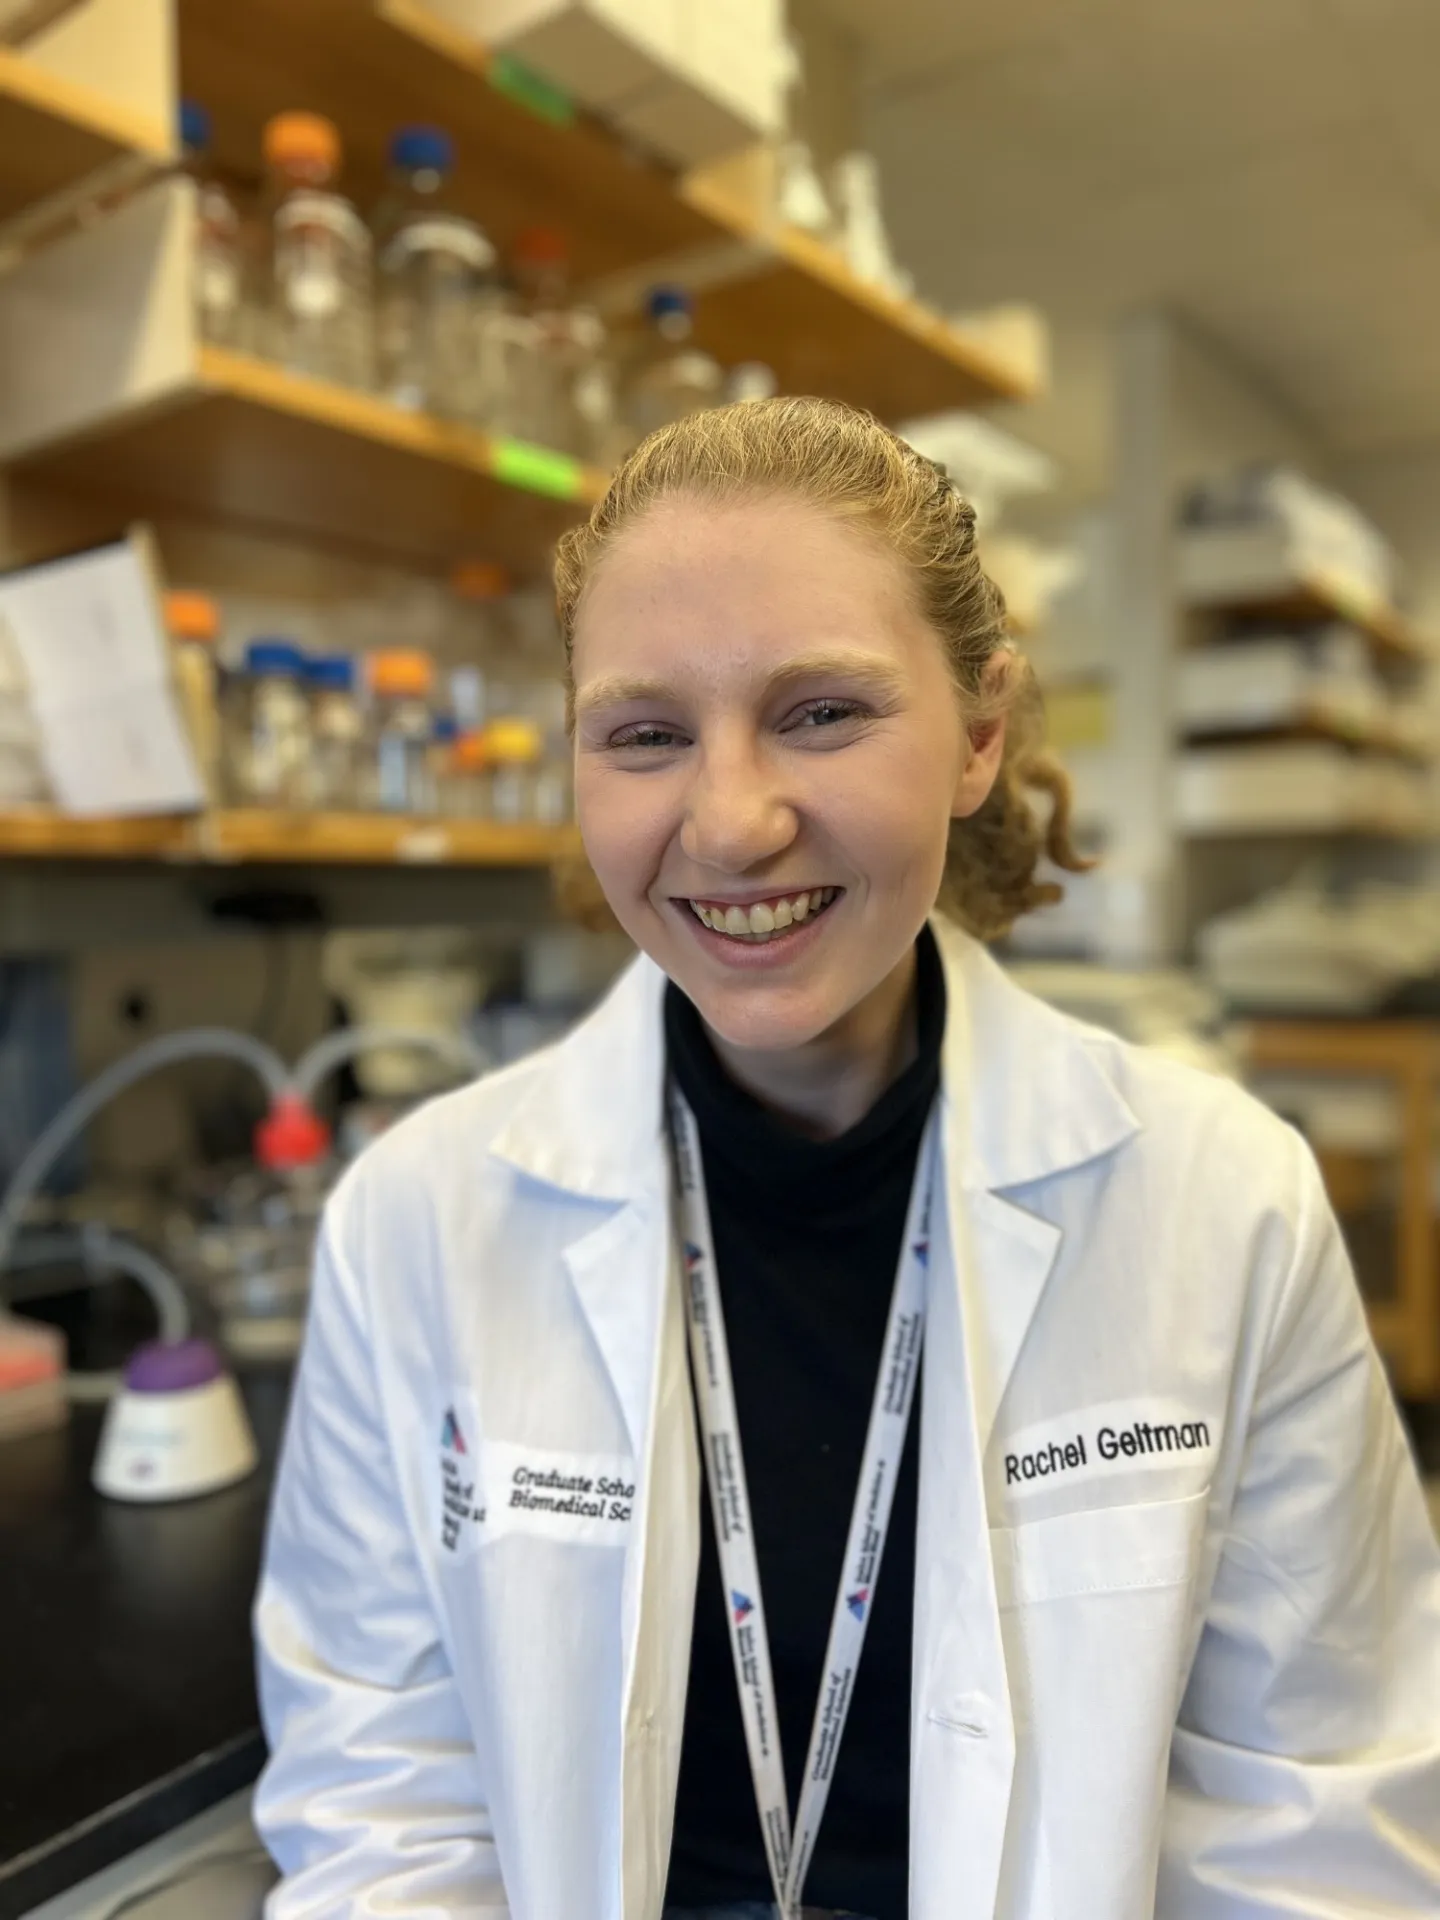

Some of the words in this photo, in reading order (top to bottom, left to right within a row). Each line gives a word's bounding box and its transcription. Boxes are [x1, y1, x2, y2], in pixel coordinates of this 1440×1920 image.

[1004, 1434, 1087, 1485] Rachel
[1096, 1421, 1211, 1460] Geltman
[512, 1466, 593, 1493] Graduate
[508, 1489, 605, 1518] Biomedical
